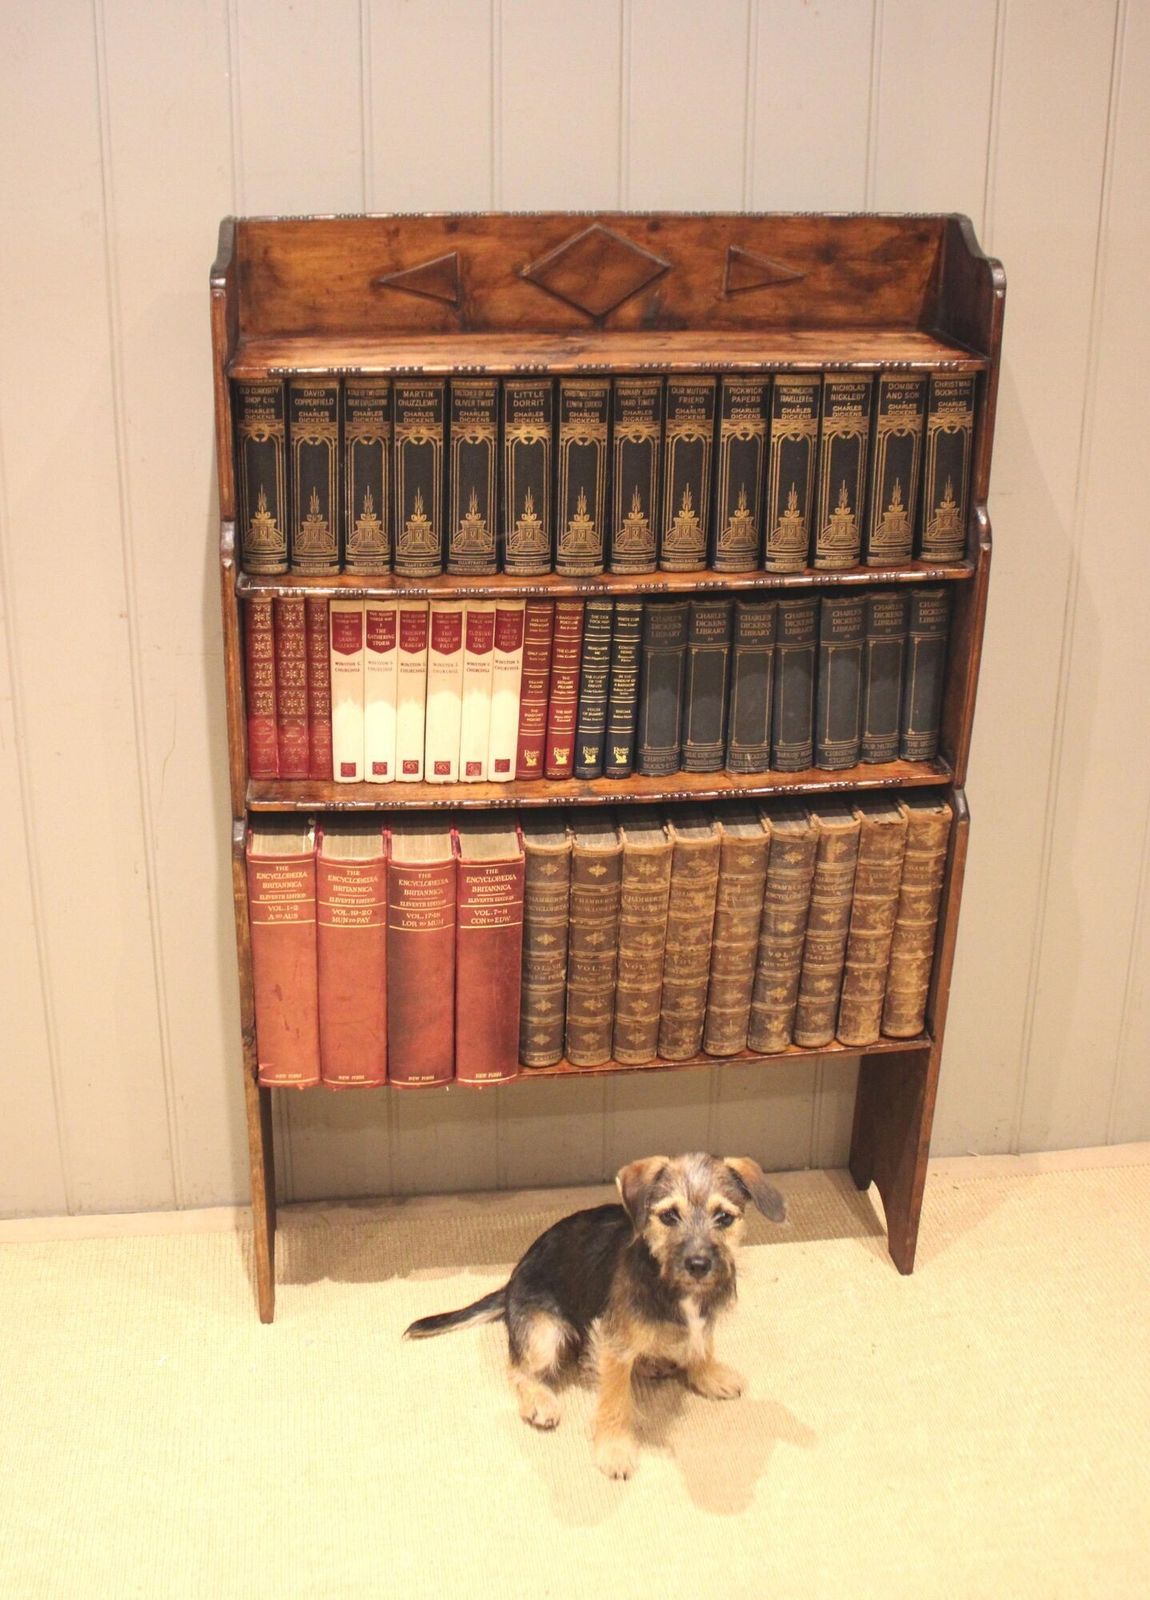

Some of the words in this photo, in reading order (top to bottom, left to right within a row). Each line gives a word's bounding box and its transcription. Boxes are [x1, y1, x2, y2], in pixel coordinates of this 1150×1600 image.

[295, 398, 334, 406] COPPERFIELD
[262, 881, 302, 889] BRITANNICA
[333, 885, 373, 893] BRITANNICA
[472, 885, 511, 893] BRITANNICA
[332, 908, 350, 916] VOL.
